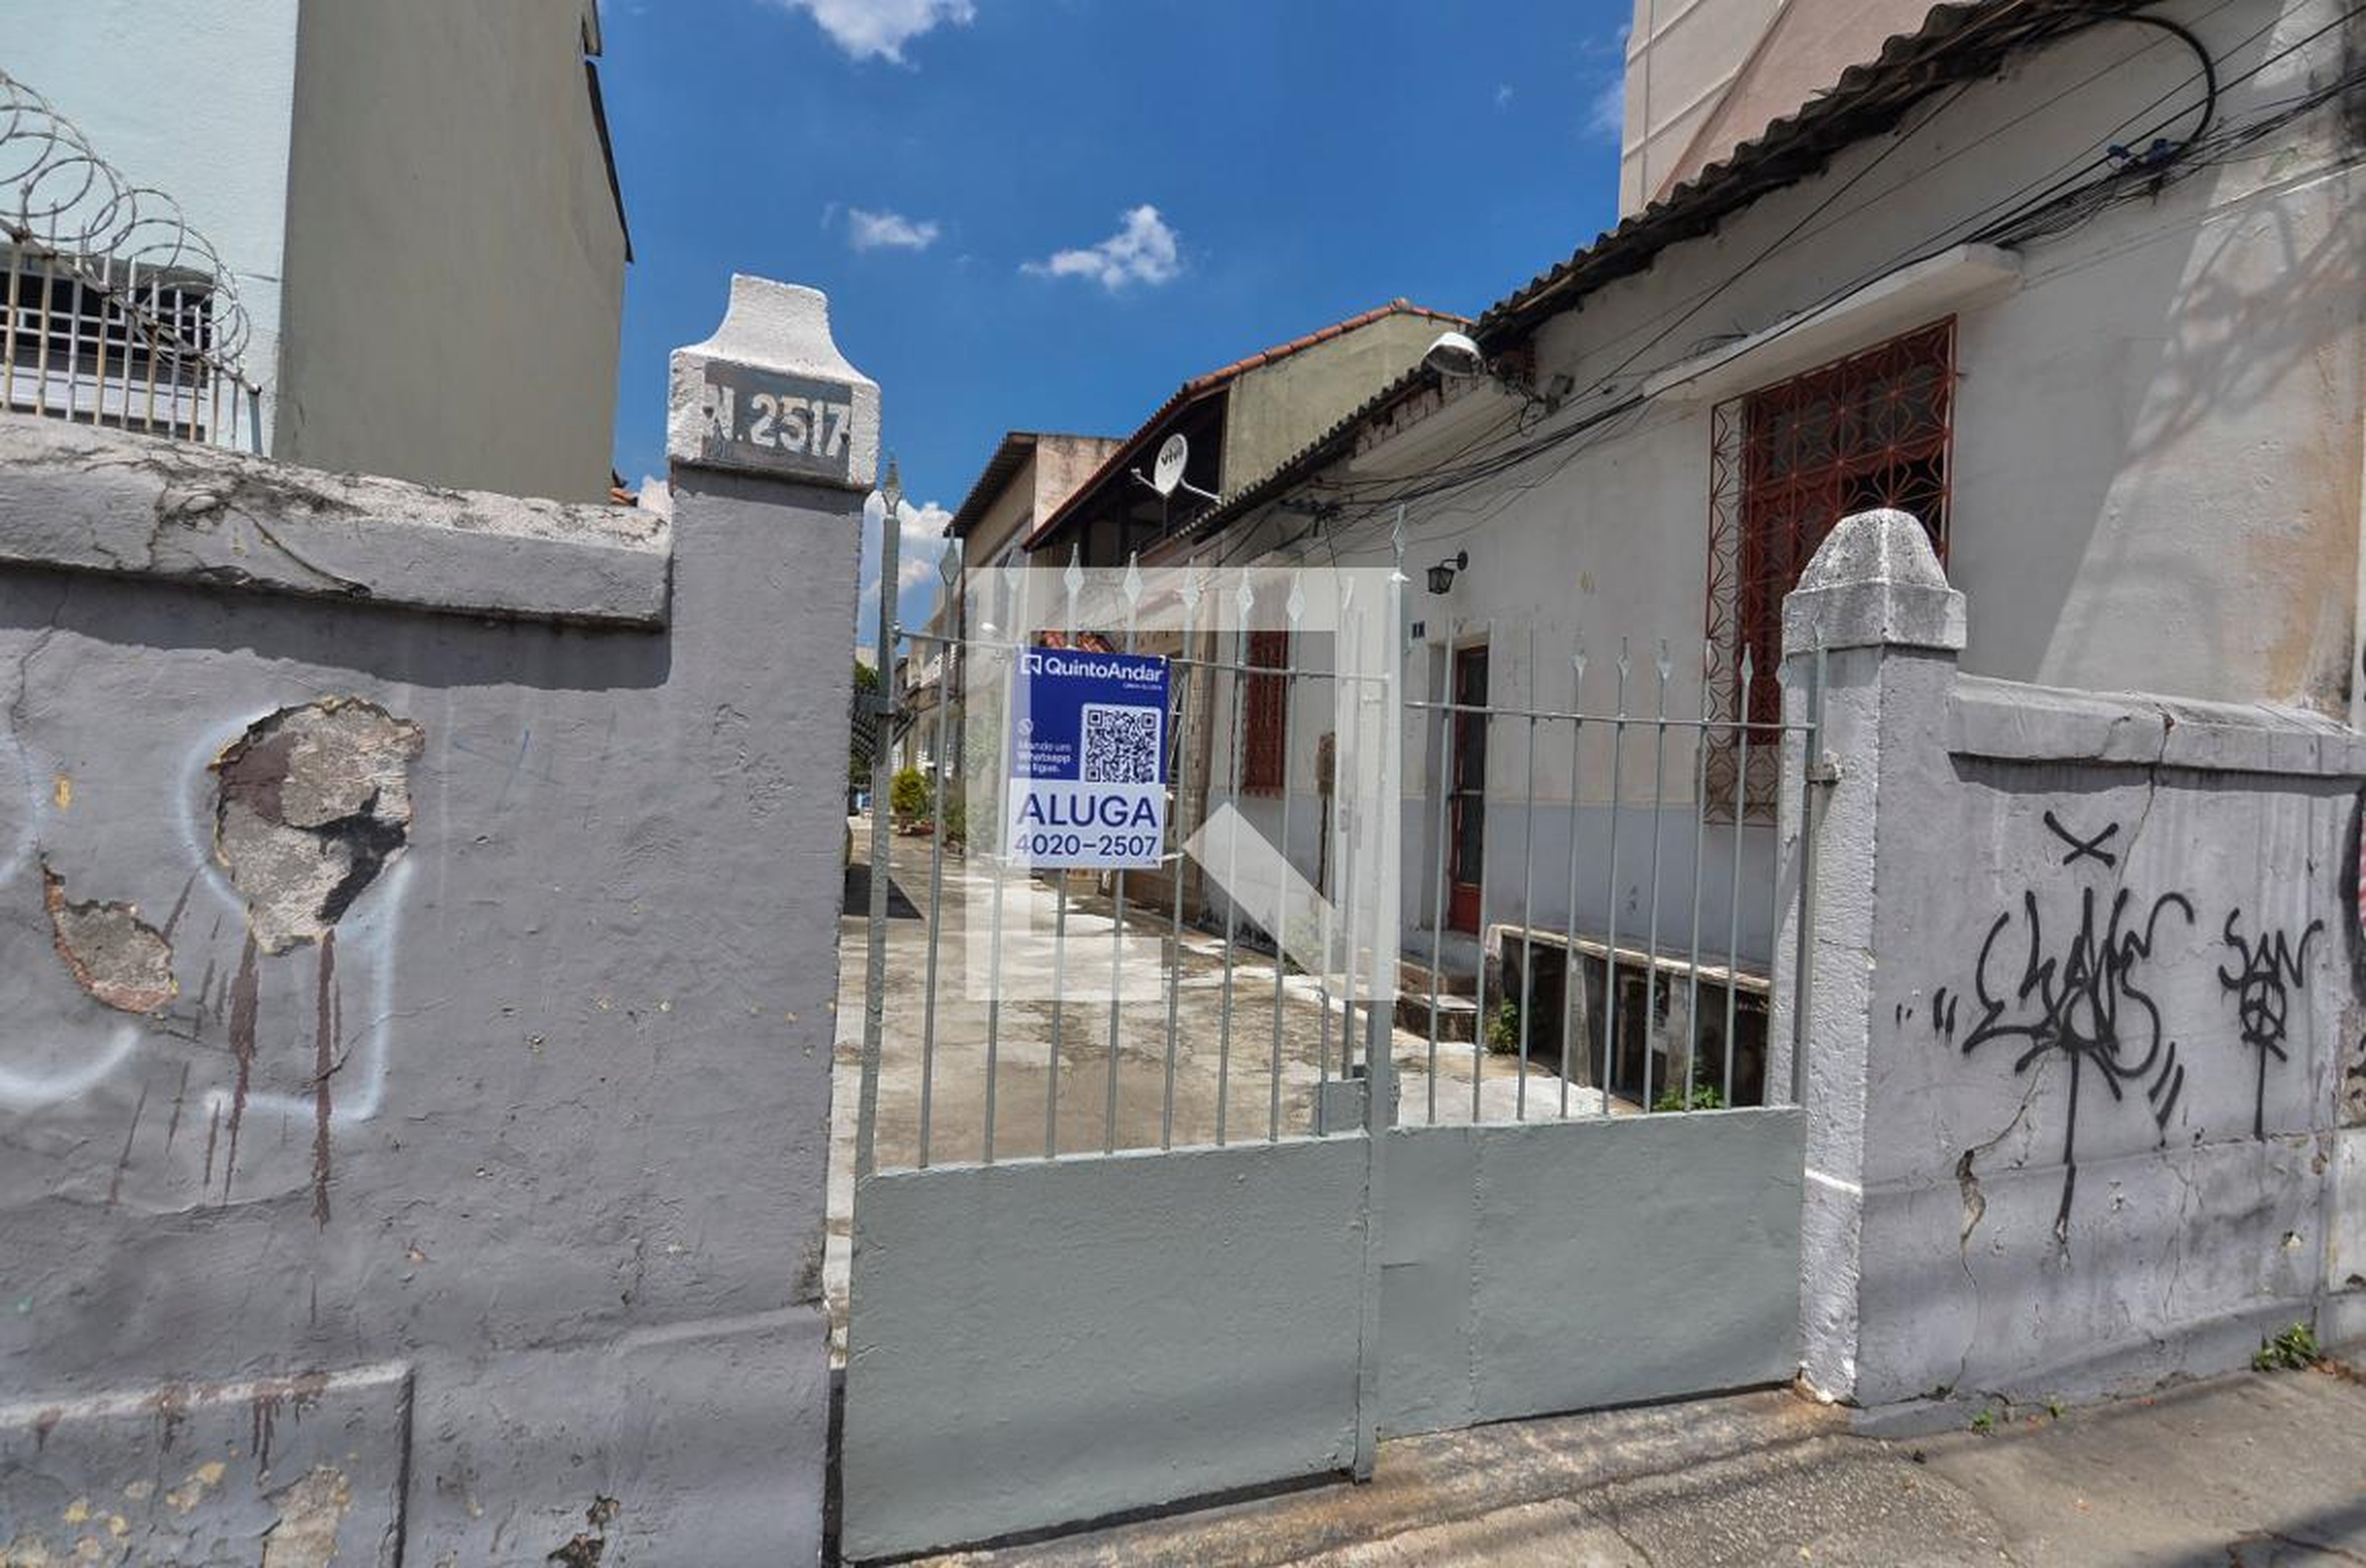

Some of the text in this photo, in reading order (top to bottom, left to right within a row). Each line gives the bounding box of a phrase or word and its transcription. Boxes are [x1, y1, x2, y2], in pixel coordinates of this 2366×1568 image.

[1045, 657, 1164, 683] QuintoAndar
[1017, 793, 1157, 827] ALUGA
[1016, 834, 1158, 856] 4020-2507
